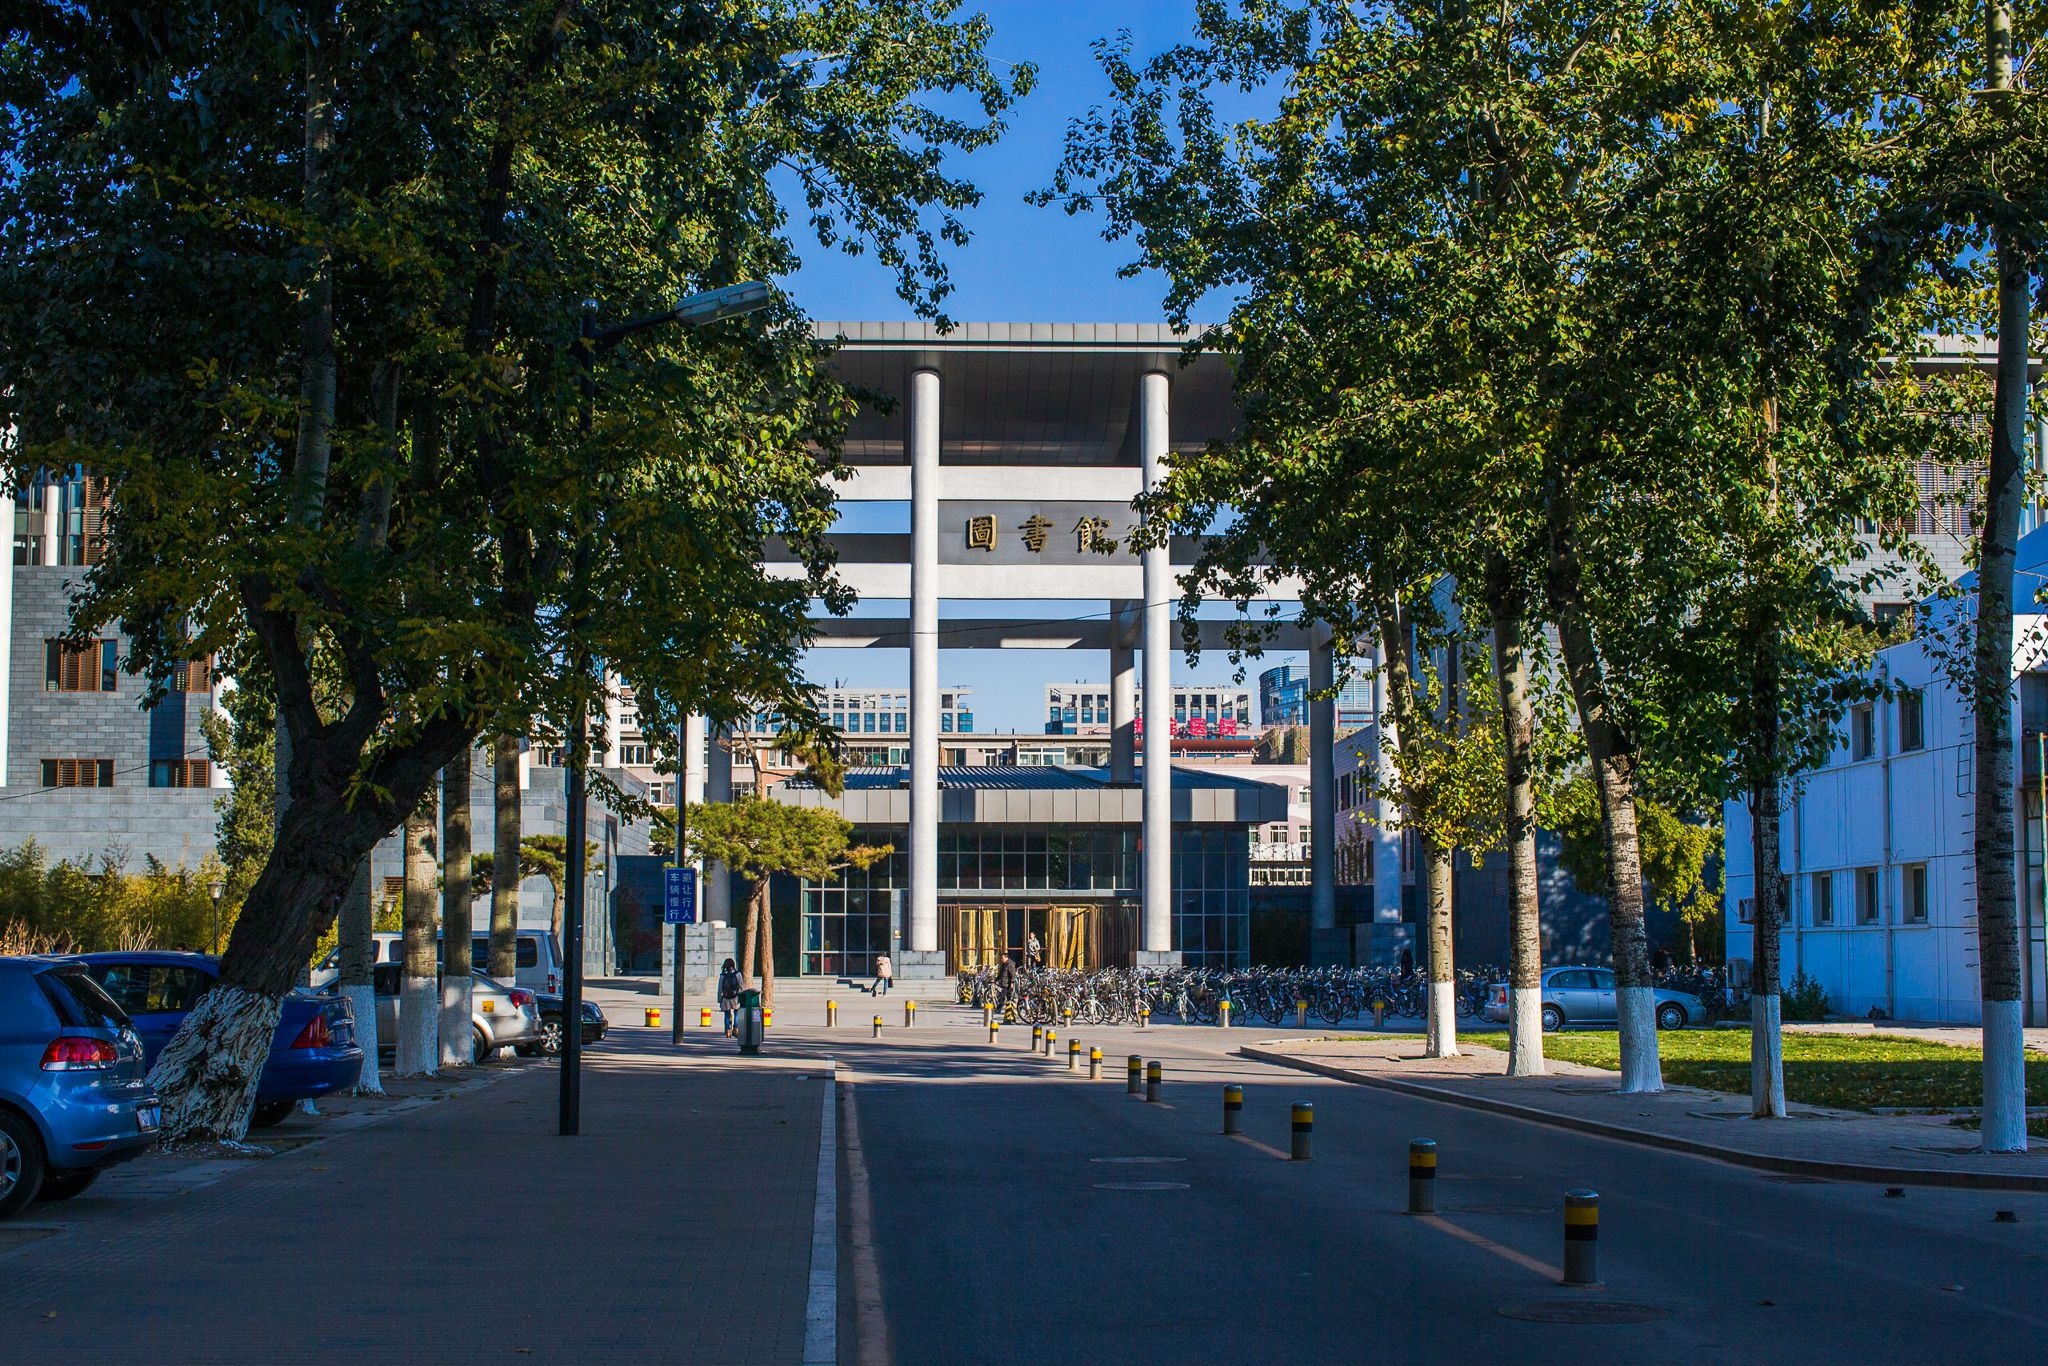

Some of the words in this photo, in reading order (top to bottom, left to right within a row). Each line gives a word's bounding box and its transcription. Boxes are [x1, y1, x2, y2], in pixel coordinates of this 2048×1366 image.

[967, 513, 1113, 552] 圖書館
[669, 873, 680, 919] 车辆慢行
[682, 873, 693, 919] 避让行人
